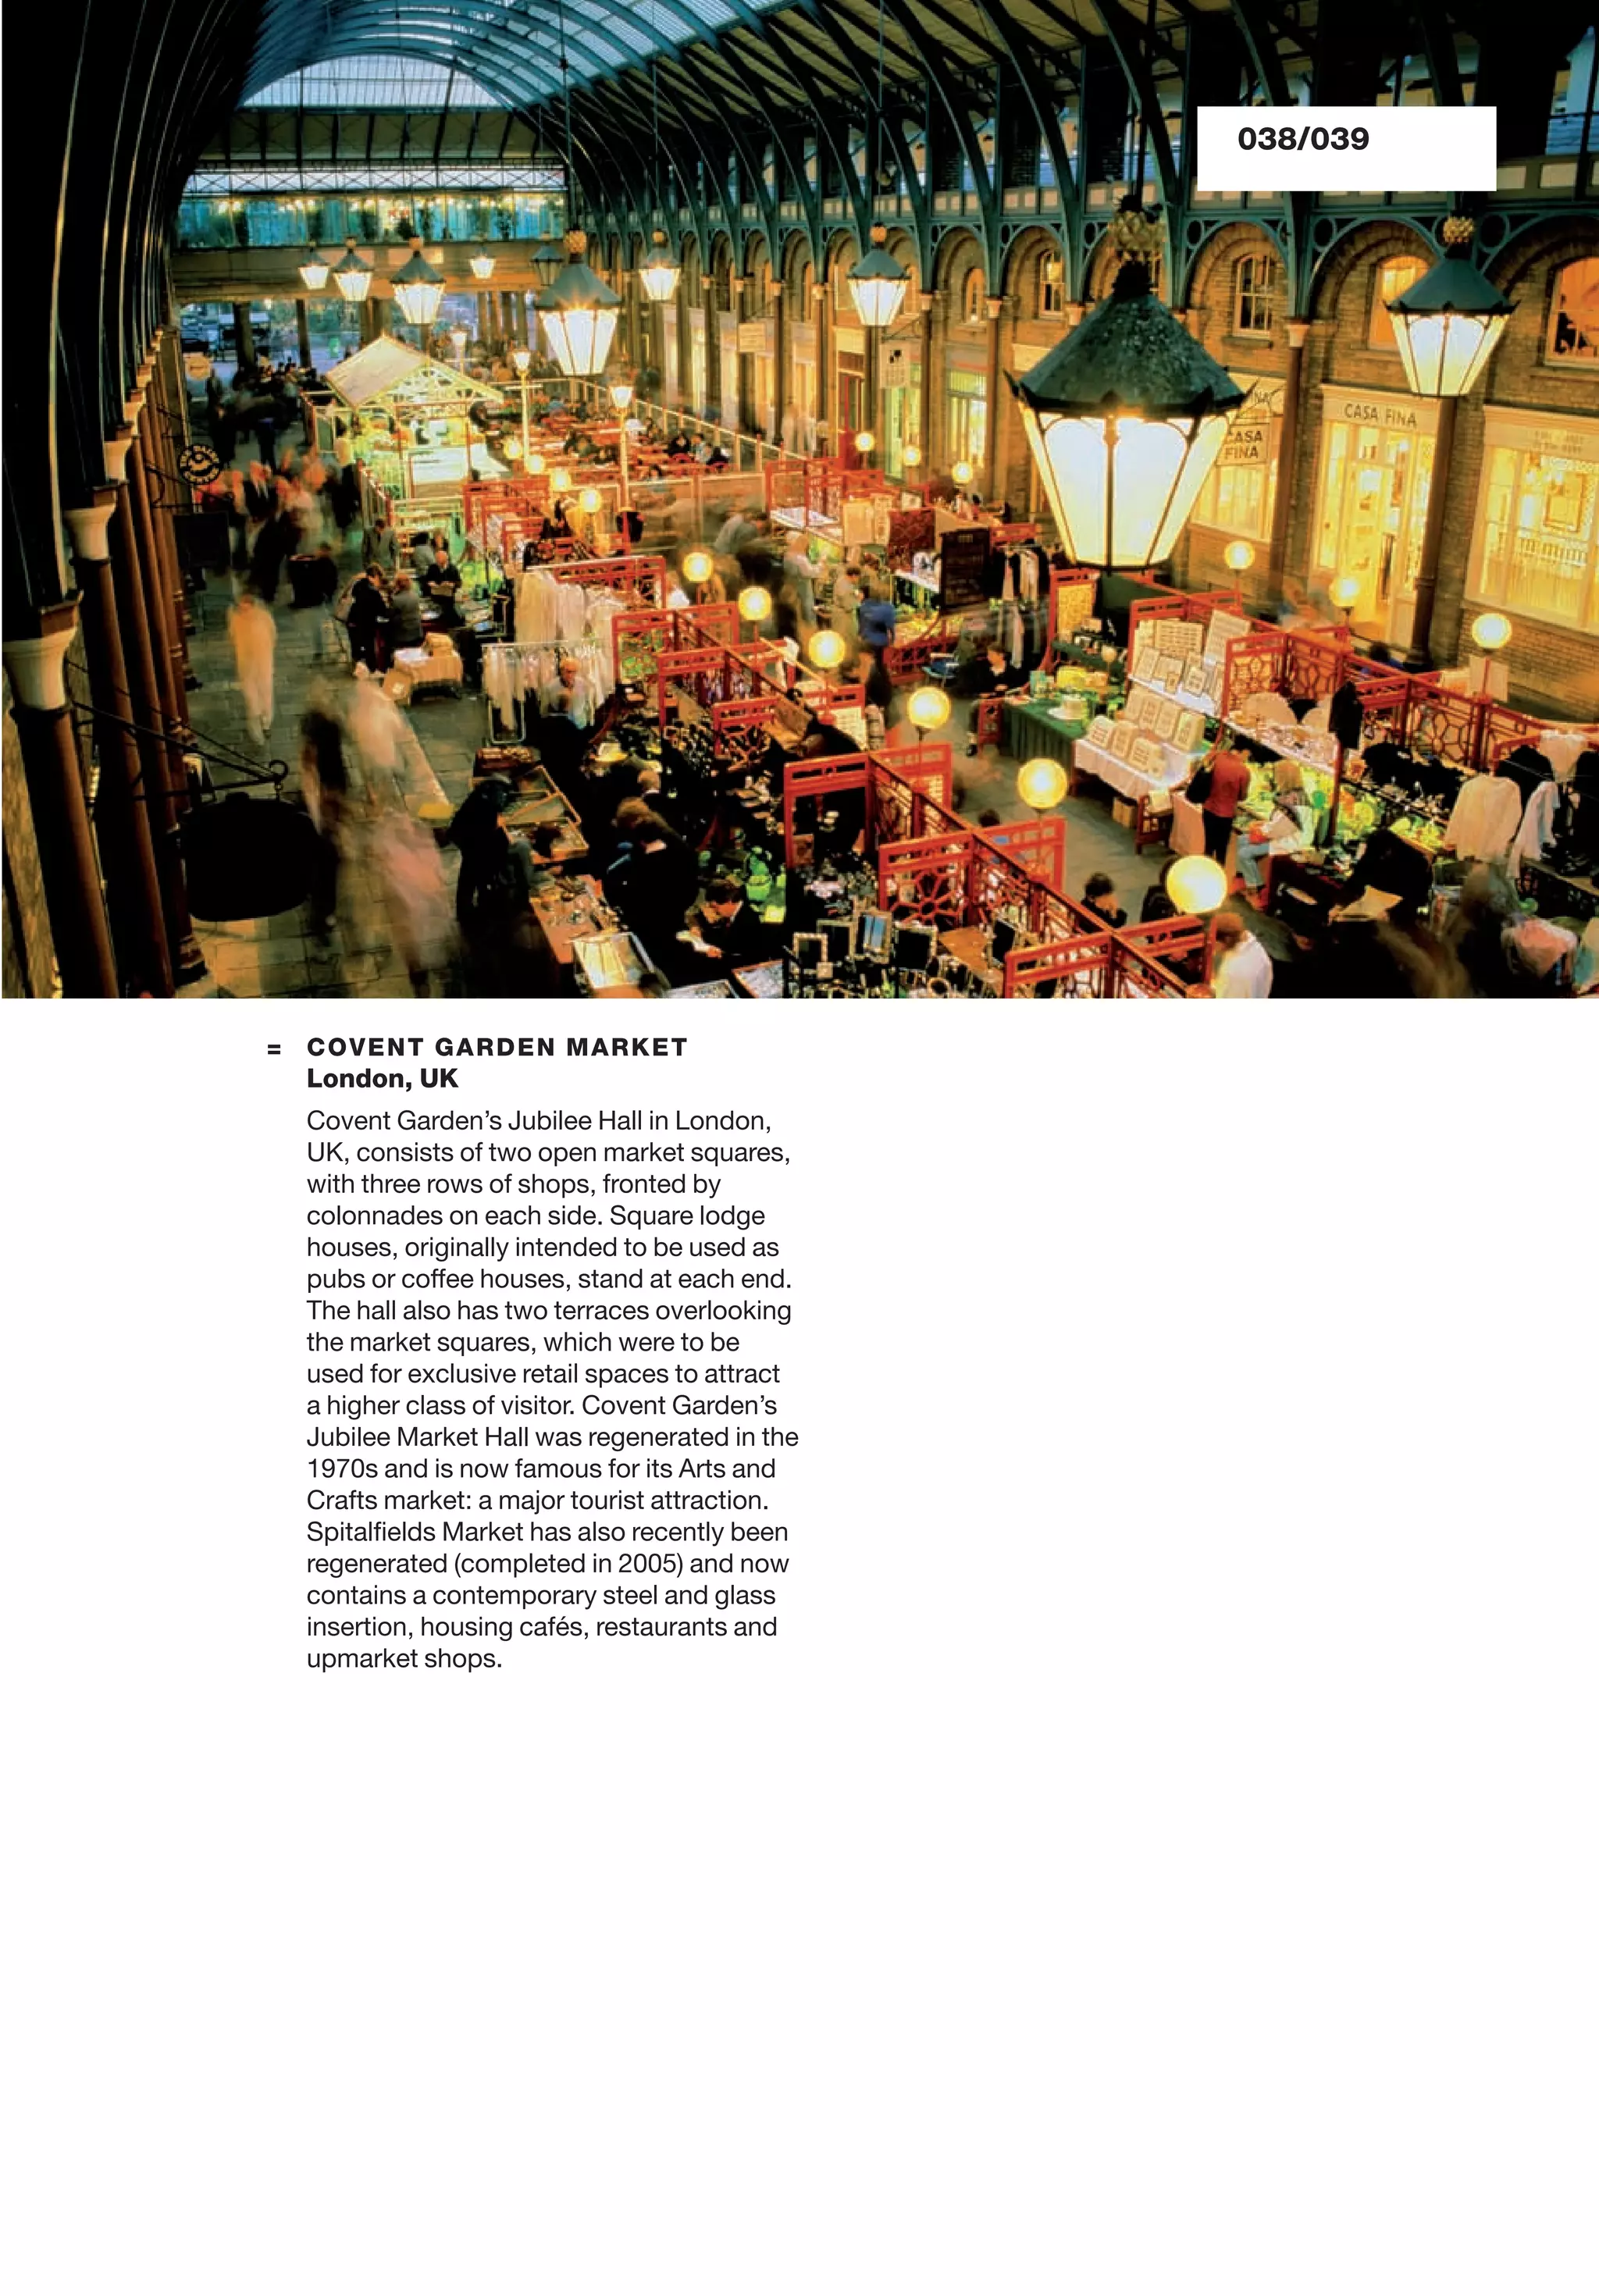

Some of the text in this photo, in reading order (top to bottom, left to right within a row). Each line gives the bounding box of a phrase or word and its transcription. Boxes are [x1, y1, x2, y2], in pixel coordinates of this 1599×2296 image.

[1344, 403, 1417, 429] CASA FINA
[1224, 446, 1259, 460] FINA
